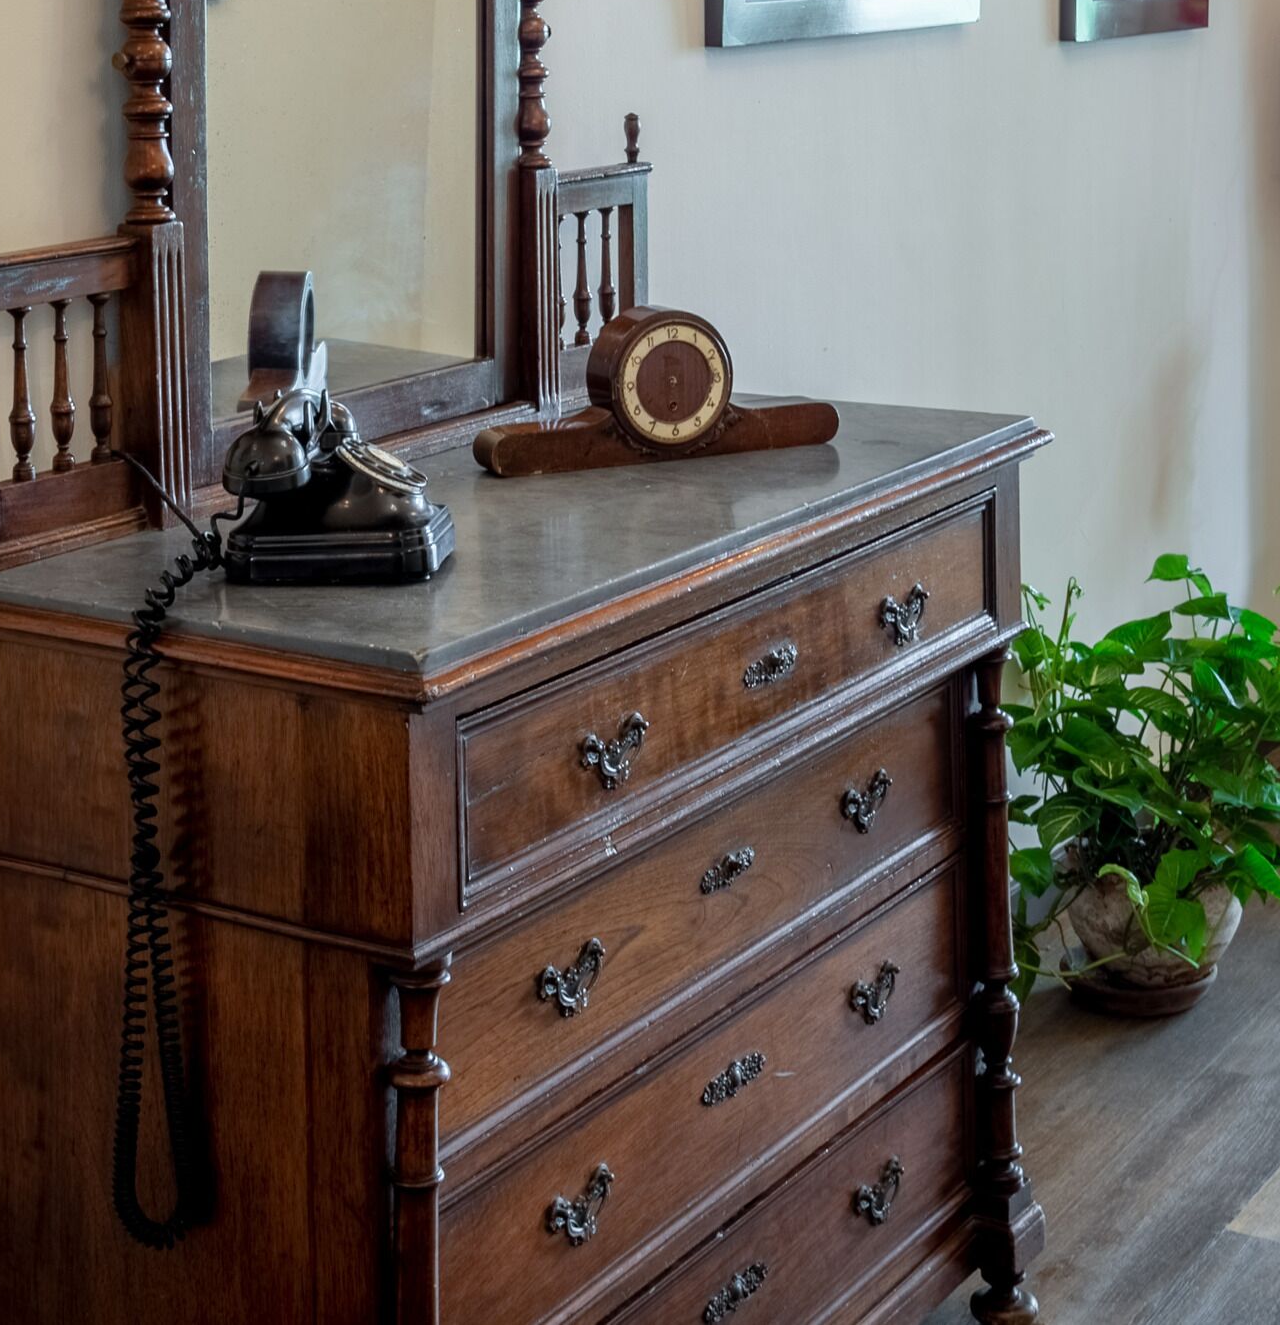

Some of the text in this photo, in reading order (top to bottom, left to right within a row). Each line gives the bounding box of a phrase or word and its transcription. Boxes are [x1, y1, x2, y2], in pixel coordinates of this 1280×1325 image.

[667, 328, 678, 338] 12
[647, 337, 654, 346] 11
[708, 349, 715, 360] 2
[631, 356, 641, 366] 10
[714, 372, 722, 383] 3
[627, 381, 634, 392] 9
[706, 396, 715, 408] 4
[648, 421, 656, 433] 7
[694, 416, 702, 427] 5
[672, 425, 679, 436] 6
